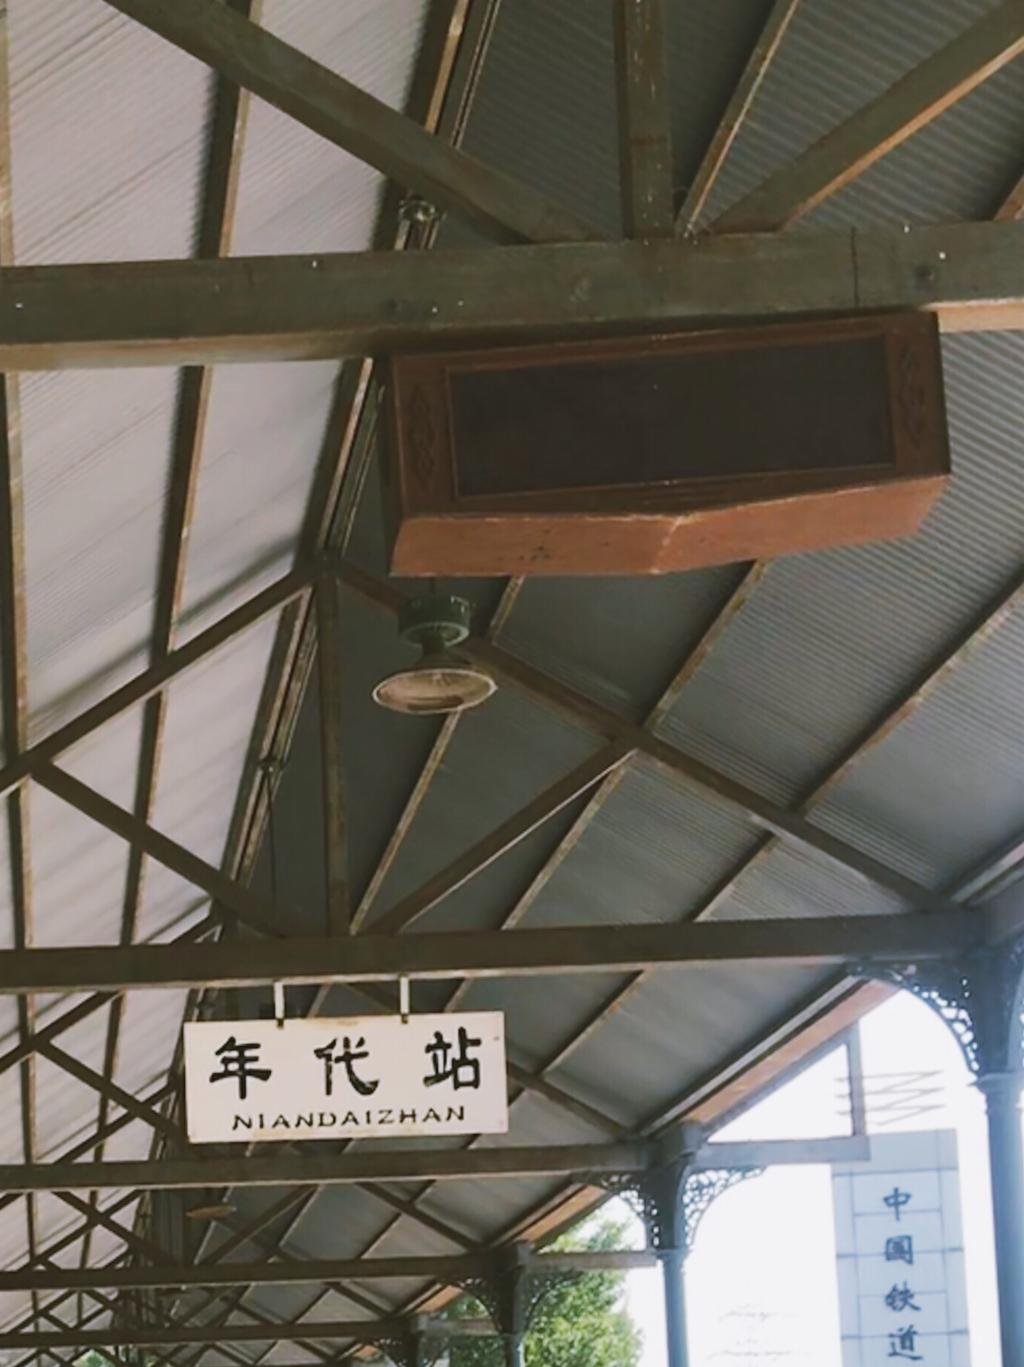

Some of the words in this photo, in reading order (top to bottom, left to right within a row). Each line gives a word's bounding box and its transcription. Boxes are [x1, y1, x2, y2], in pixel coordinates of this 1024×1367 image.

[209, 1027, 482, 1100] 年代站
[232, 1105, 466, 1131] NIANDAIZHAN
